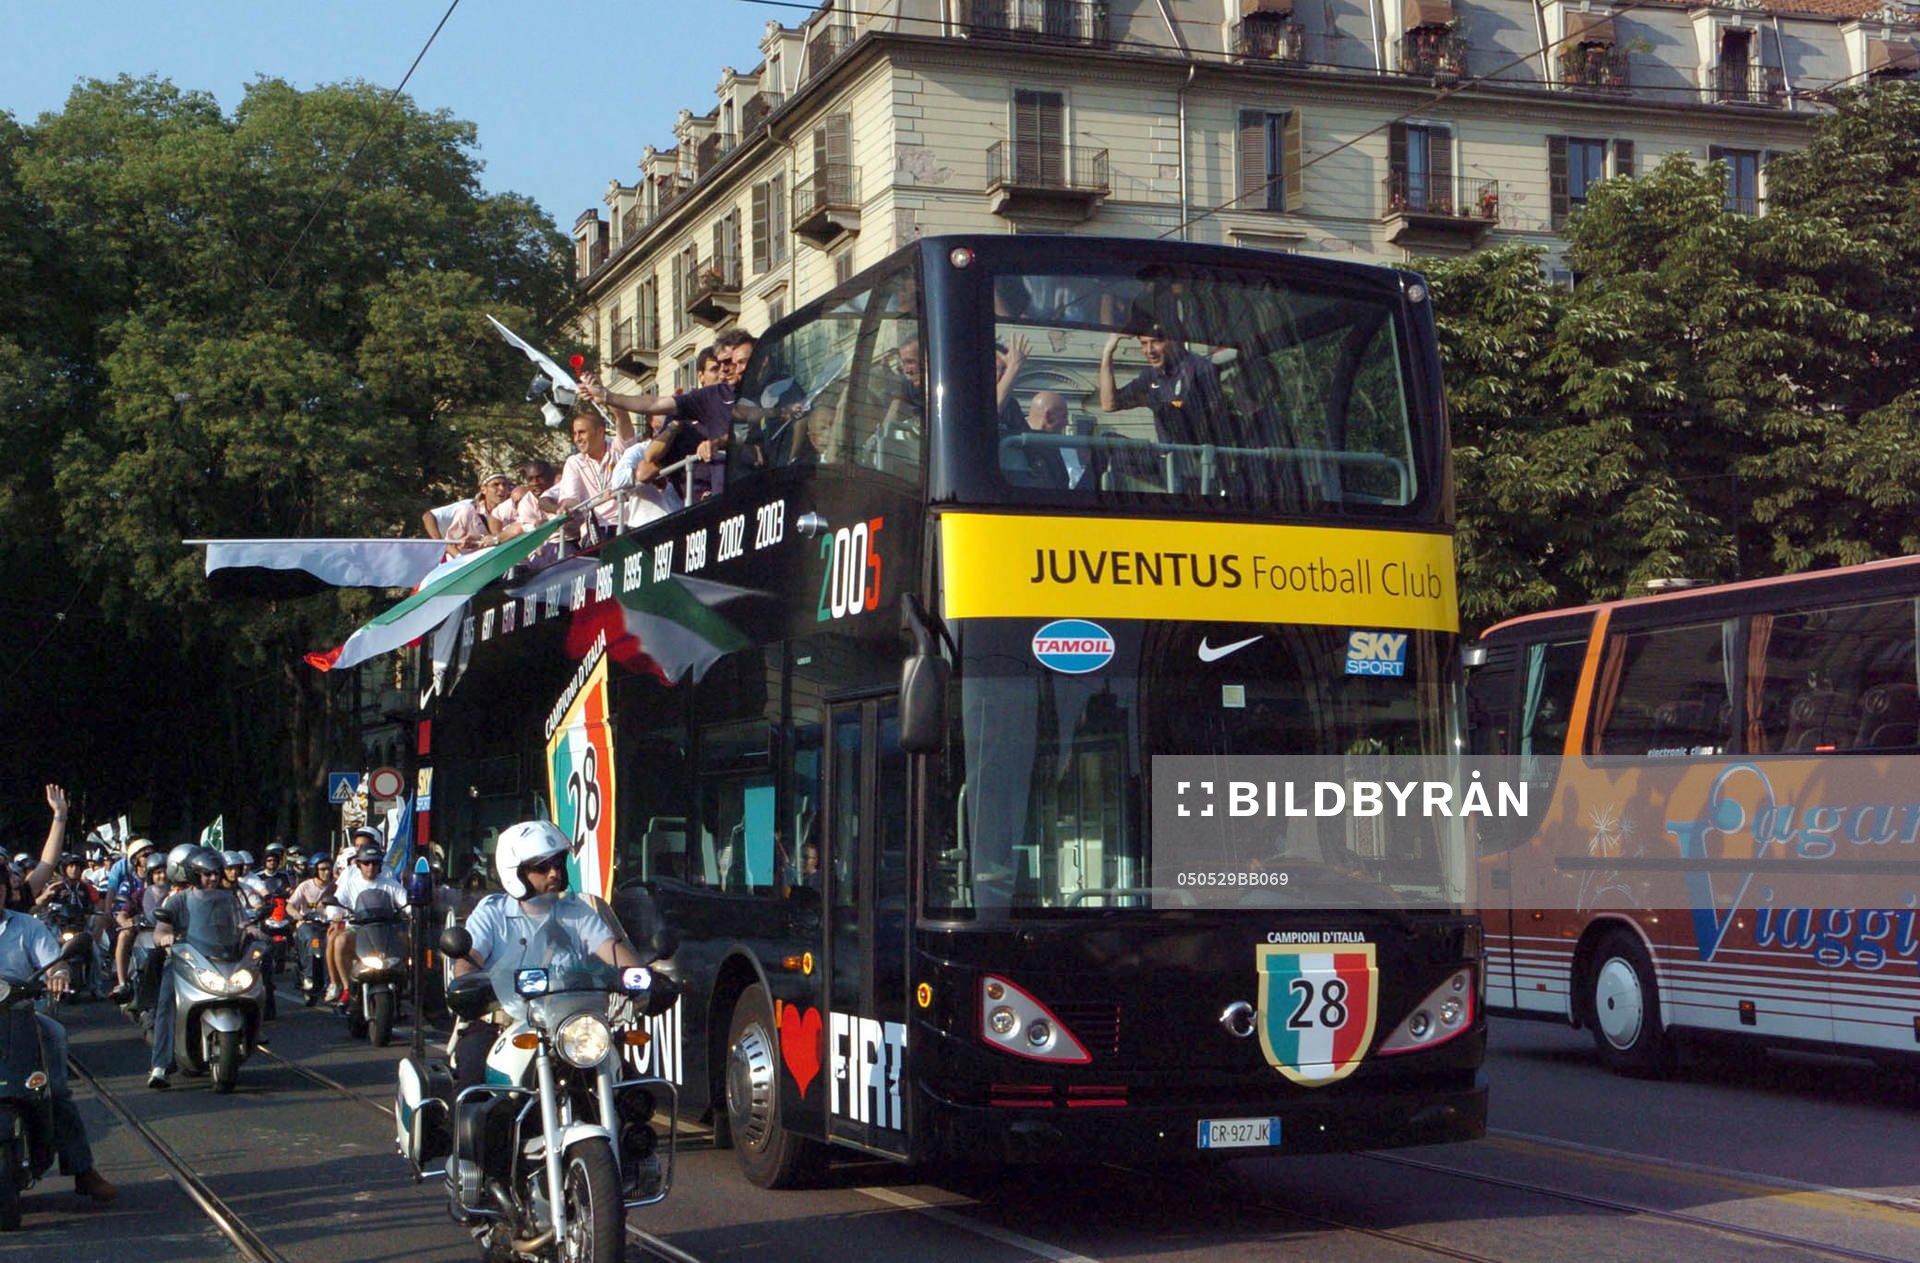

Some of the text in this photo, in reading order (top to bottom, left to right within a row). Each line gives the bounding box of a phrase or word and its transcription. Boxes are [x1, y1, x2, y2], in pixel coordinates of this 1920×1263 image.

[595, 562, 614, 603] 1986
[623, 551, 642, 593] 1995
[652, 540, 674, 584] 1997
[685, 528, 707, 574] 1998
[717, 514, 745, 563] 2002
[755, 499, 785, 551] 2003
[817, 516, 884, 622] 2005
[1030, 548, 1442, 600] JUVENTUS Football Club
[1035, 639, 1113, 653] TAMOIL
[1347, 631, 1408, 661] SKY
[1347, 660, 1404, 676] SPORT
[567, 744, 601, 860] 28
[1267, 931, 1365, 943] CAMPIONI D'ITALIA
[1287, 979, 1349, 1031] 28
[829, 1011, 908, 1131] FIAT
